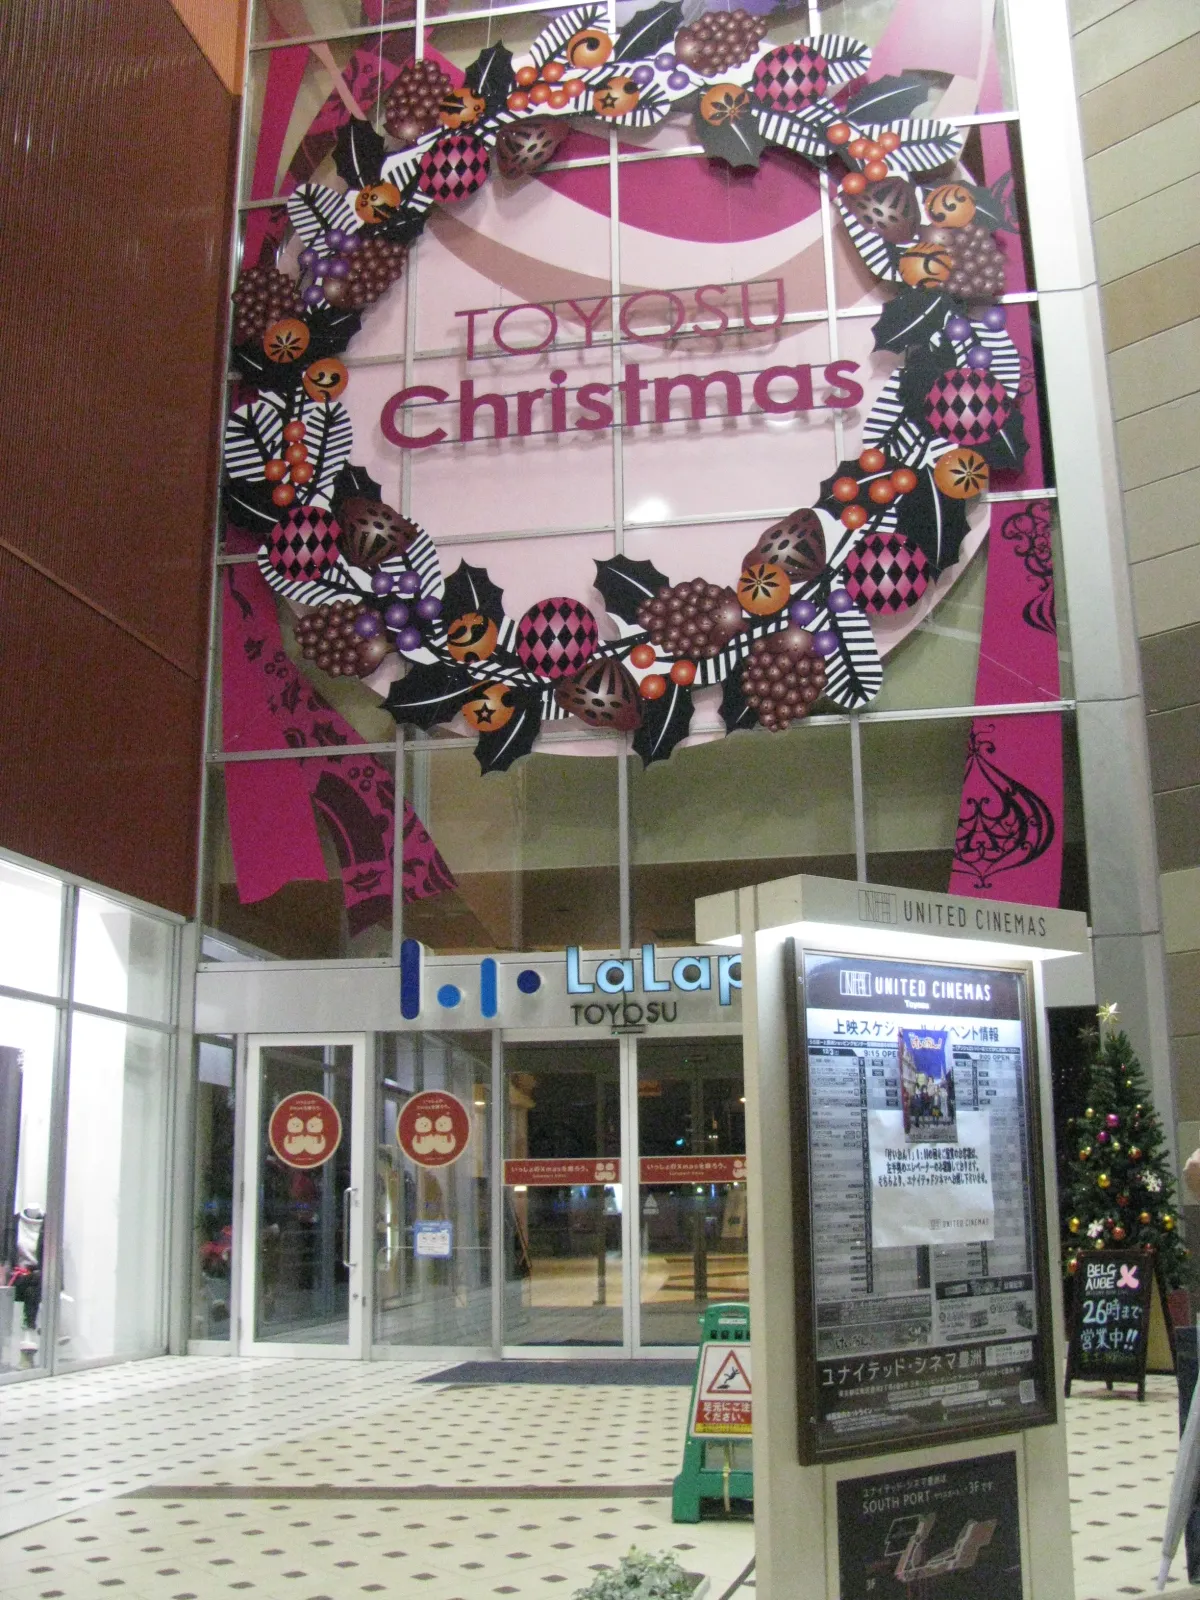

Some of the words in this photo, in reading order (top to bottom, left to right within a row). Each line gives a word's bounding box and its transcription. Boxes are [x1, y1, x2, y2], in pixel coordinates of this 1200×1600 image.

[454, 278, 786, 361] TOYOSU
[380, 359, 864, 449] Christmas
[903, 900, 967, 928] UNITED
[975, 909, 1047, 937] CINEMAS
[874, 976, 927, 998] UNITED
[932, 980, 992, 1002] CINEMAS
[571, 1002, 678, 1025] TOYOSU
[1086, 1263, 1117, 1278] BELG
[1084, 1277, 1114, 1291] AUBE
[1082, 1298, 1143, 1324] 26時まで
[863, 1496, 900, 1514] SOUTH
[903, 1490, 931, 1506] PORT
